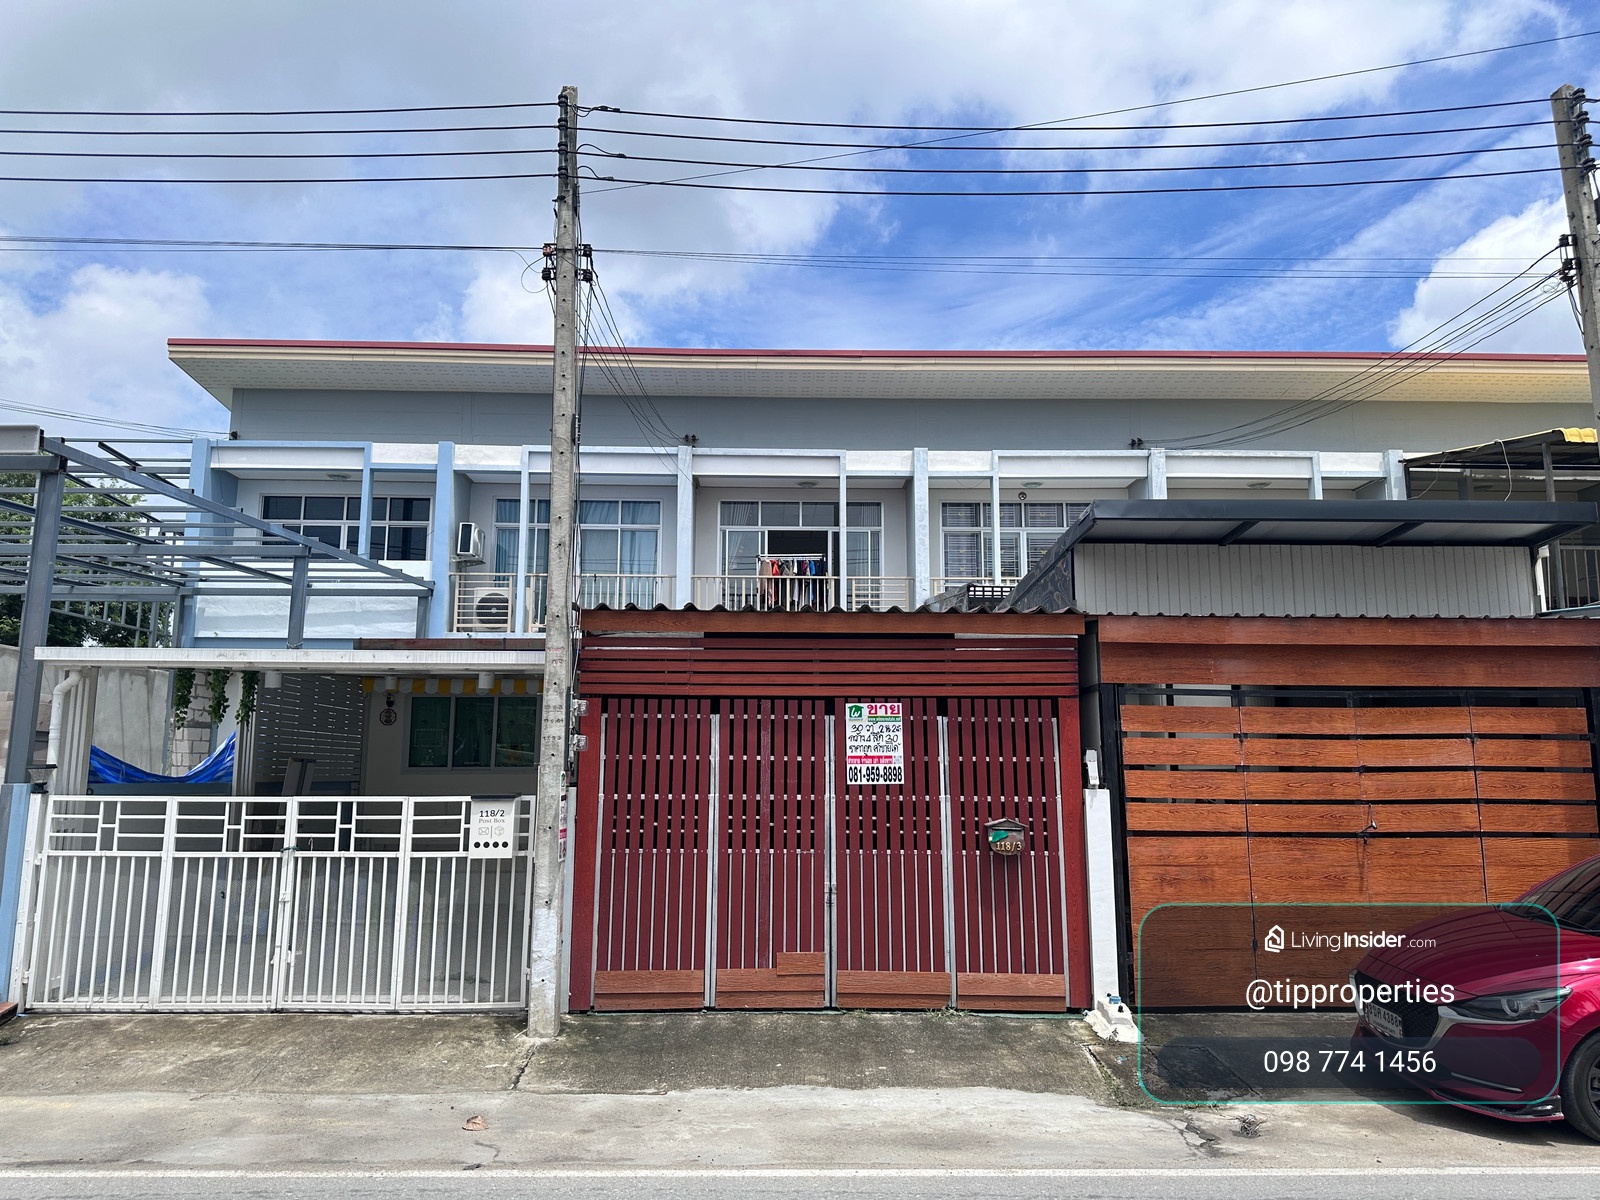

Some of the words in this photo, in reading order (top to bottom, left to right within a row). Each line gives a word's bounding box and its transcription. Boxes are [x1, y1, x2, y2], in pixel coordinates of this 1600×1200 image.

[867, 704, 901, 715] ขาย
[848, 766, 903, 783] 081-959-8898
[479, 809, 505, 818] 118/2
[996, 841, 1022, 851] 118/3
